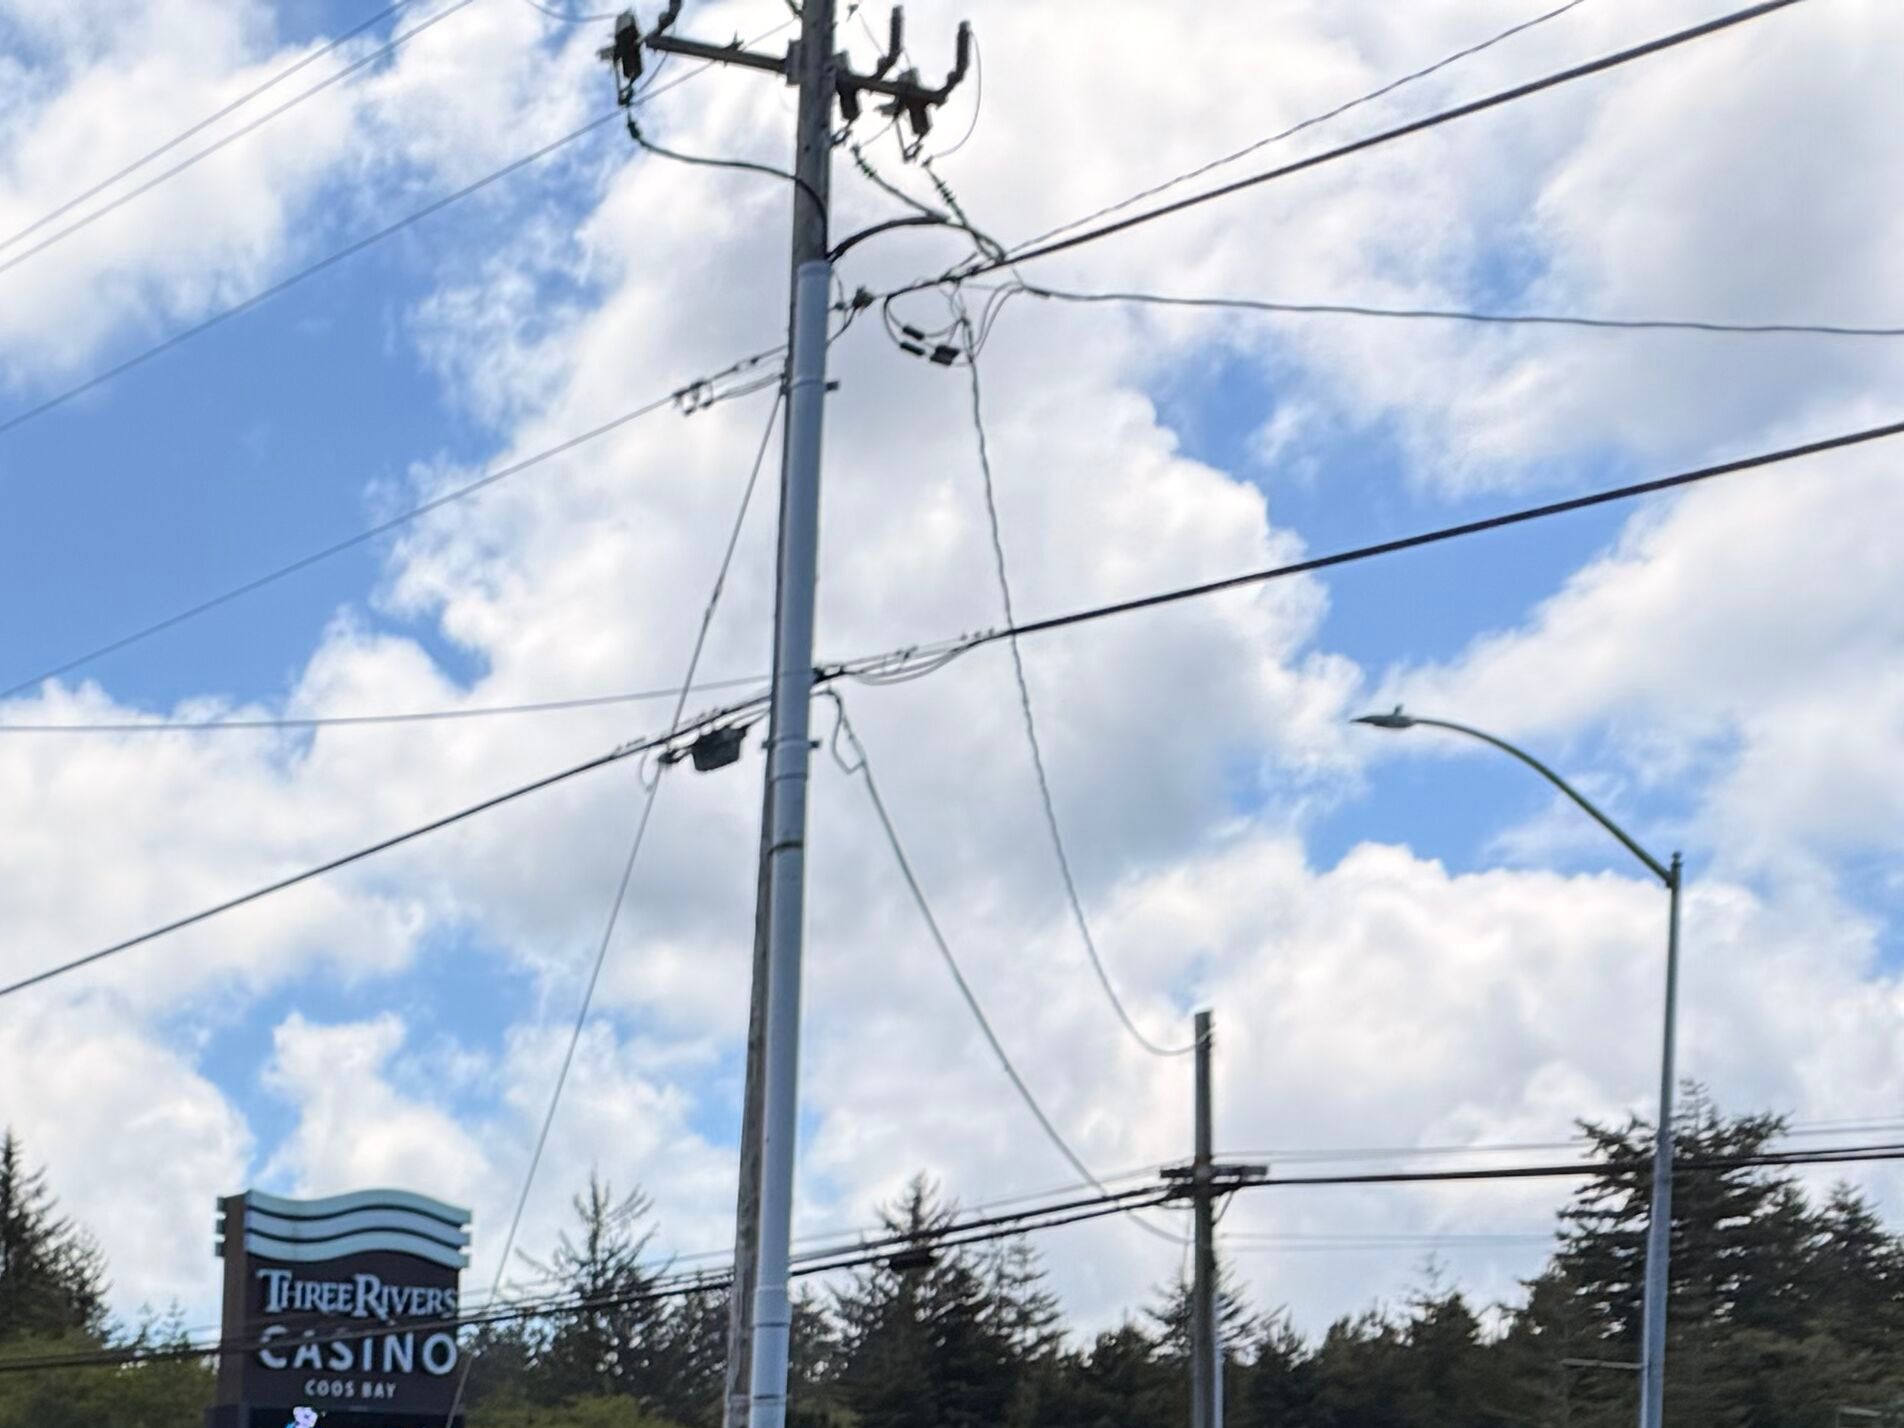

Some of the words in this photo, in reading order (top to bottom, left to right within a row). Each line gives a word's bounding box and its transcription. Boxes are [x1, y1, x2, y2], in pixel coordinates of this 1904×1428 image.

[258, 1324, 458, 1375] CASINO
[304, 1379, 355, 1398] COOS
[361, 1380, 397, 1399] BAY
